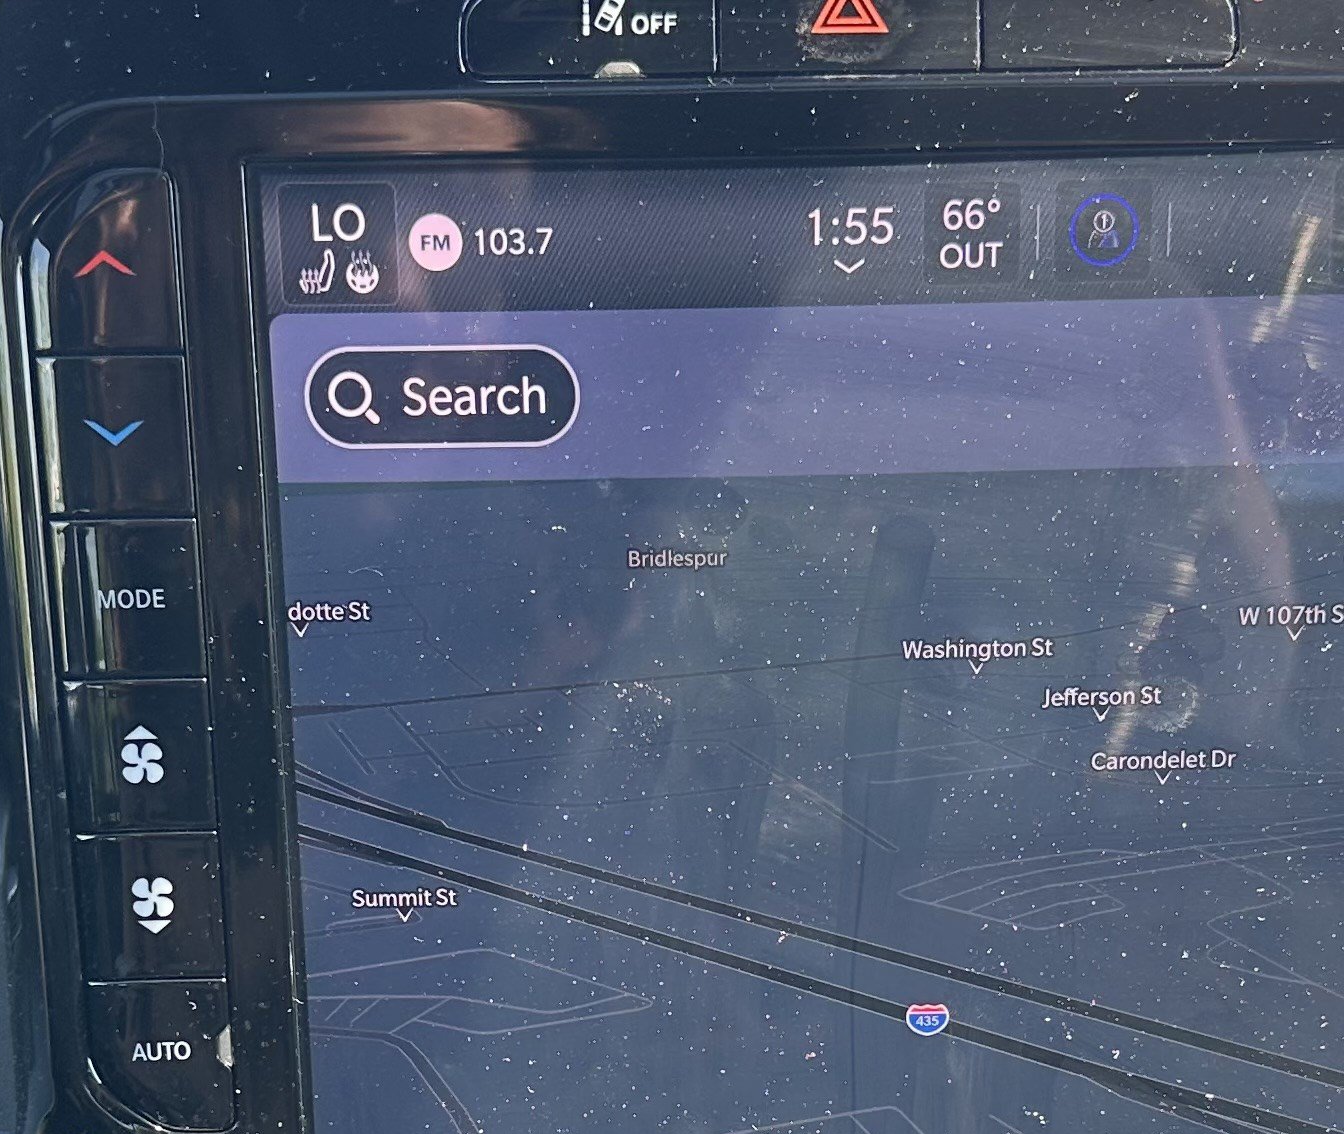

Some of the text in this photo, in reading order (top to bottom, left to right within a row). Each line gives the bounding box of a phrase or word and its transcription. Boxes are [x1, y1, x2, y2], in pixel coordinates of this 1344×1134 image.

[631, 13, 677, 36] OFF
[312, 203, 365, 243] LO
[808, 207, 895, 246] 1:55
[420, 228, 553, 256] FM 103.7
[939, 242, 1003, 271] OUT
[402, 377, 546, 417] Search
[628, 550, 728, 569] Bridlespur
[97, 589, 166, 609] MODE
[288, 602, 371, 622] dotte St
[1240, 608, 1262, 627] W
[1266, 605, 1326, 626] 107th
[903, 638, 1054, 662] Washington St
[1042, 687, 1162, 709] Jefferson St
[1091, 750, 1237, 771] Carondelet Dr
[352, 889, 457, 907] Summit St
[915, 1015, 940, 1028] 435
[132, 1042, 191, 1062] AUTO
